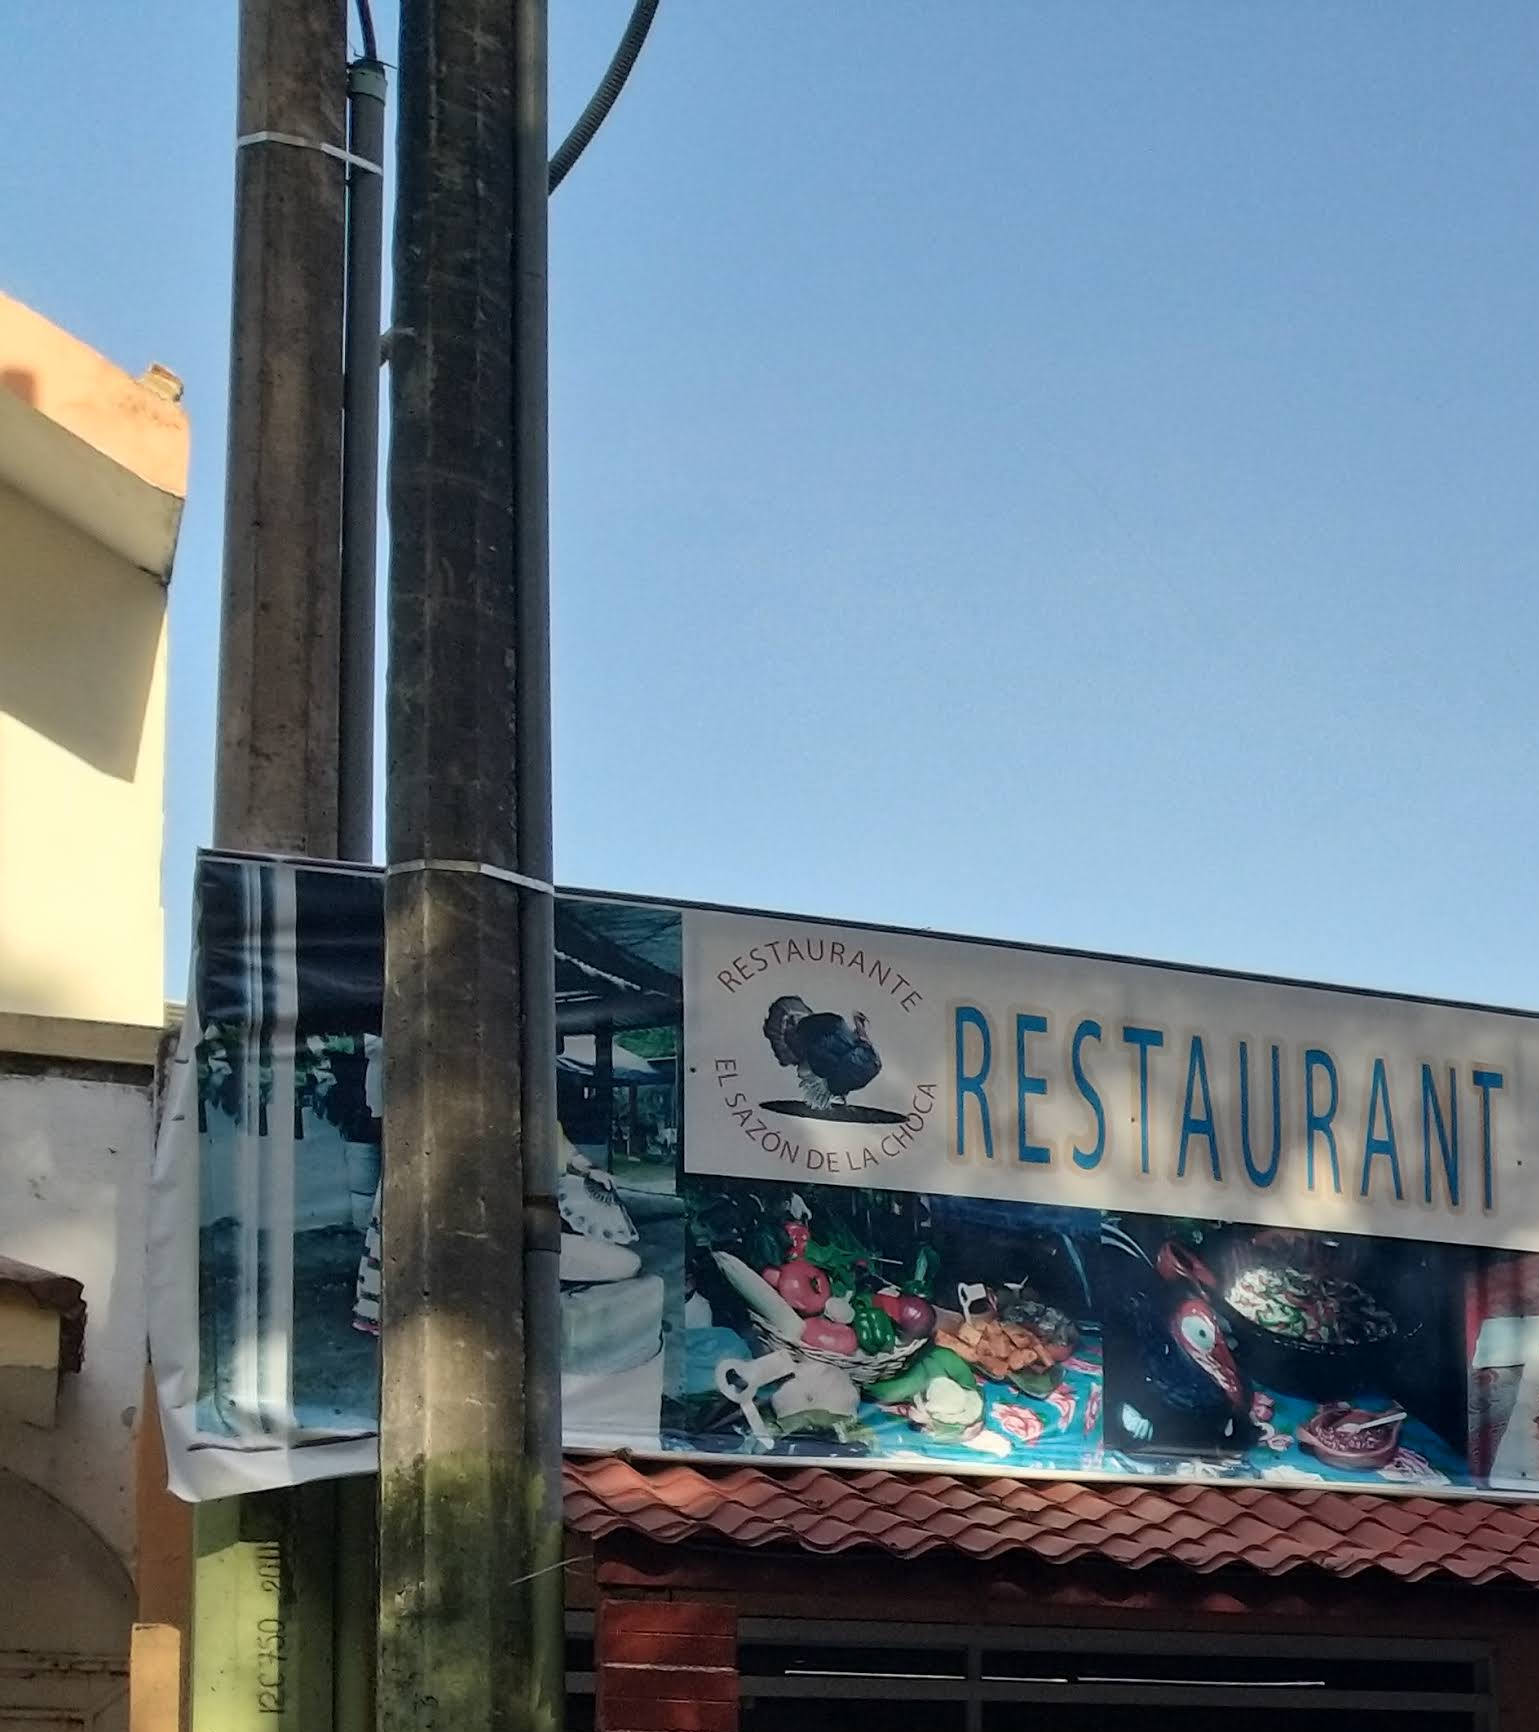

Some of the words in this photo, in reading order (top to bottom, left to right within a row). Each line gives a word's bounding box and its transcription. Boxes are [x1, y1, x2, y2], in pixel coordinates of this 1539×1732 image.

[716, 938, 924, 1014] RESTAURANTE
[714, 1058, 739, 1087] EL
[954, 1005, 1504, 1211] RESTAURANT
[724, 1092, 801, 1164] SAZÓN
[881, 1081, 938, 1158] CHOCA
[806, 1149, 840, 1173] DE
[848, 1148, 879, 1171] LA
